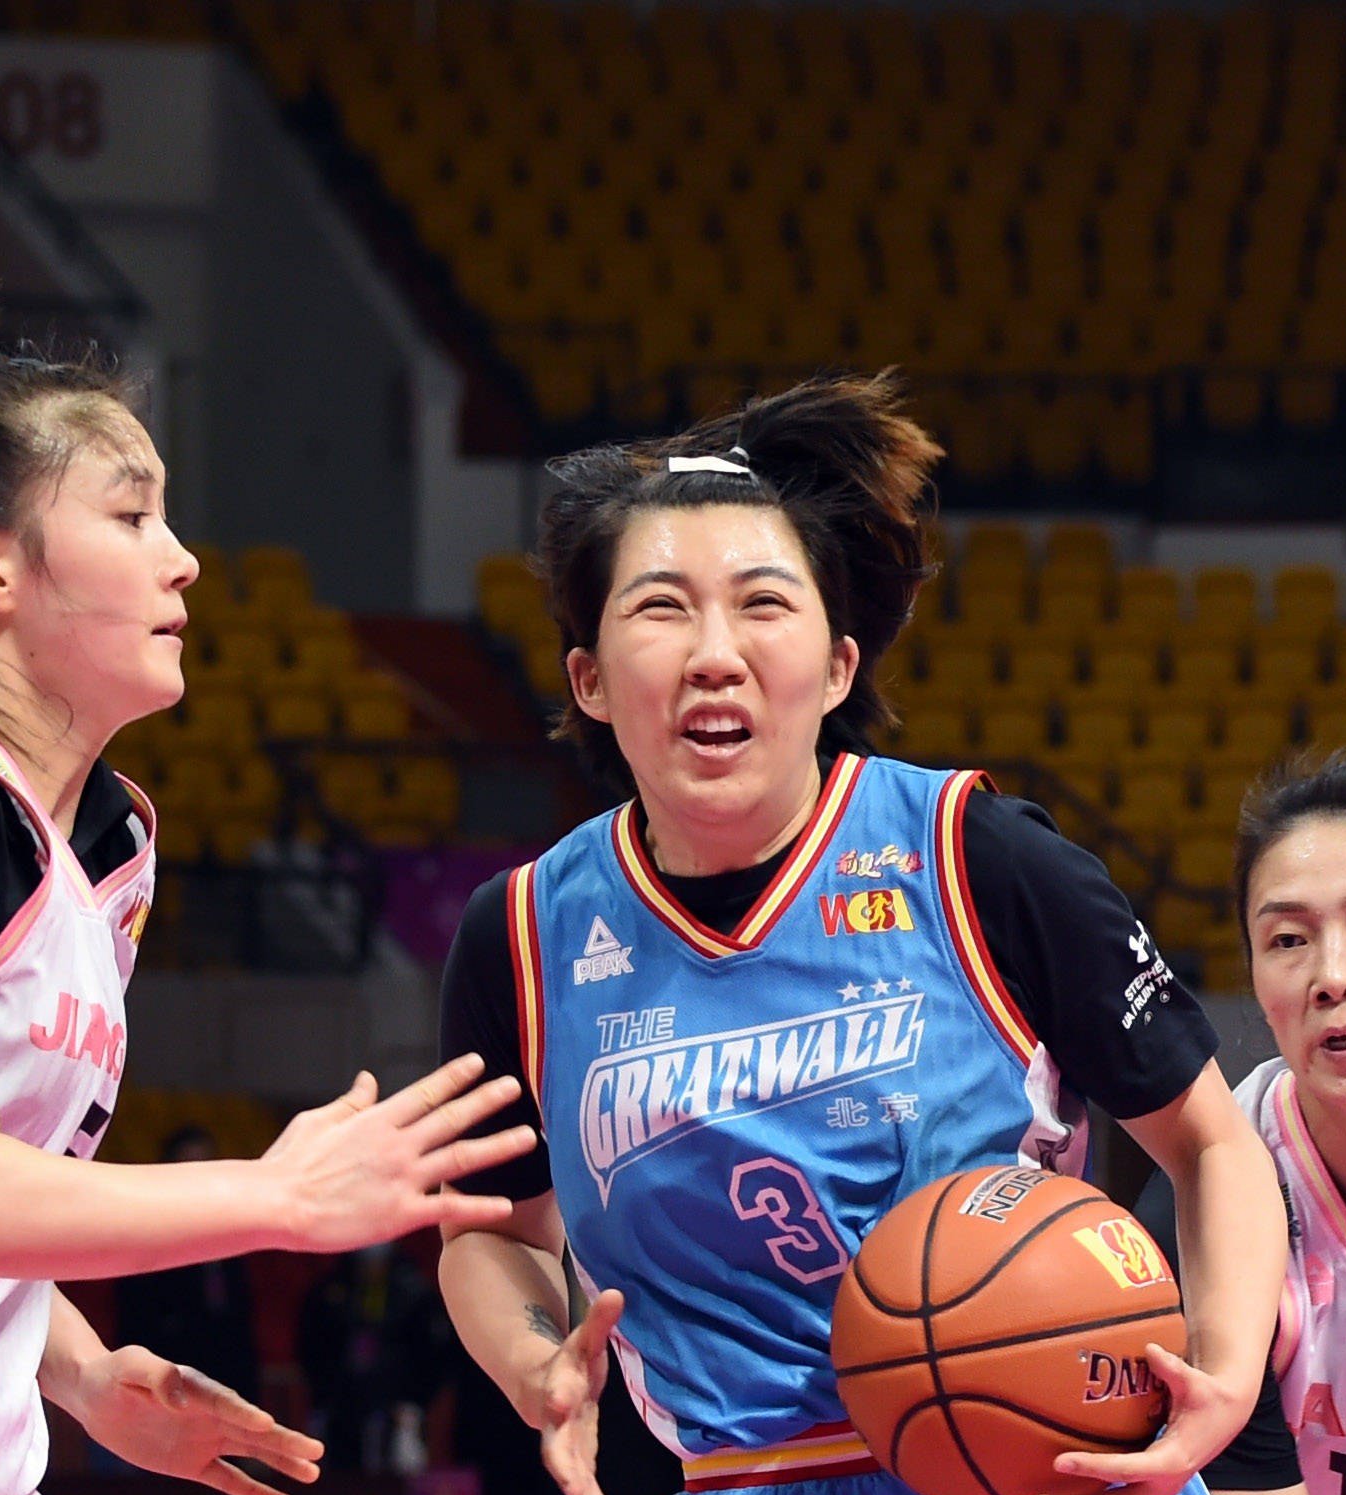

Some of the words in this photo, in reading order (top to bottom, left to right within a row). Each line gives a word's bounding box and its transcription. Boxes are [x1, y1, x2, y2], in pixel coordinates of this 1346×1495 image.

[573, 945, 635, 986] PEAK
[596, 1005, 676, 1055] THE
[826, 1091, 921, 1130] 北京
[728, 1156, 850, 1284] 3
